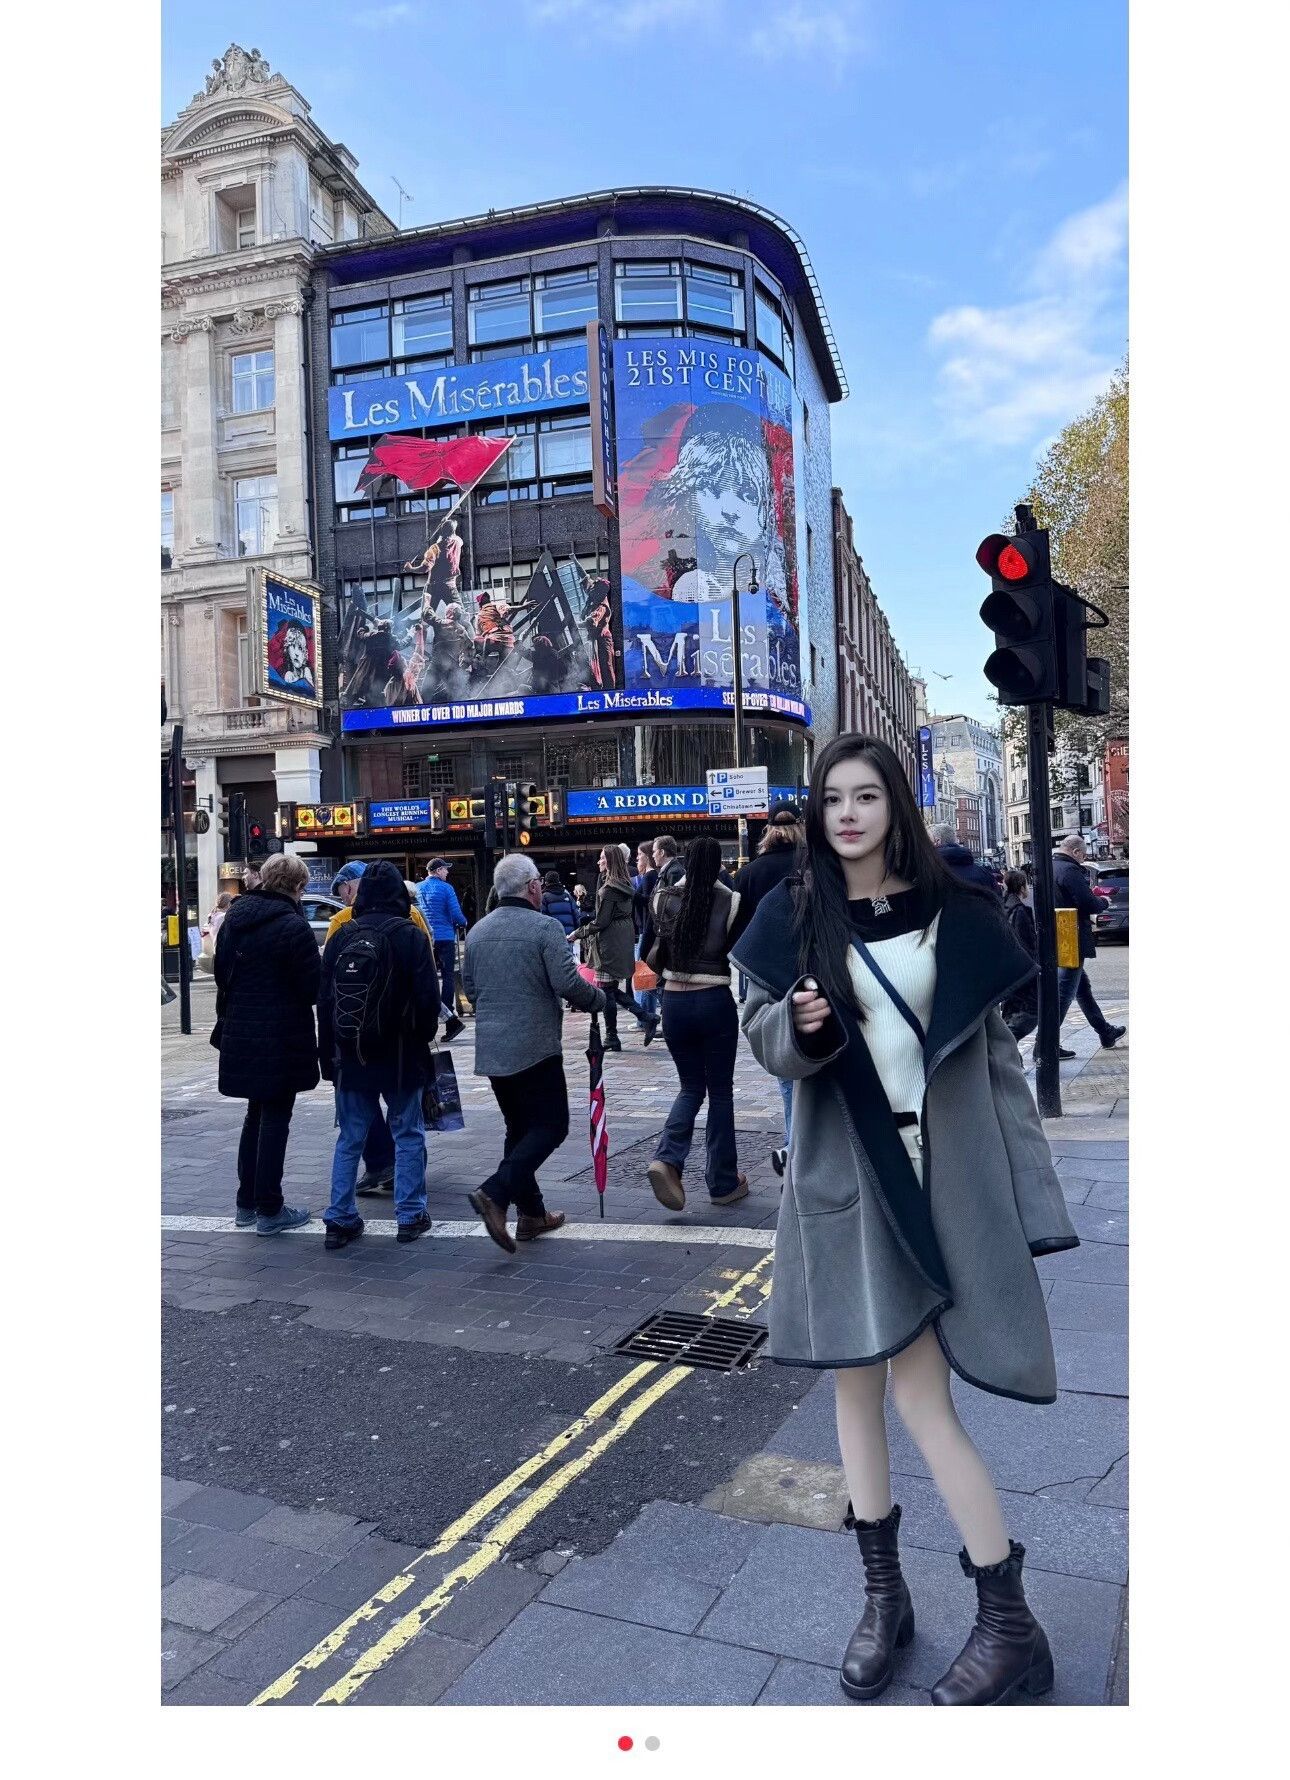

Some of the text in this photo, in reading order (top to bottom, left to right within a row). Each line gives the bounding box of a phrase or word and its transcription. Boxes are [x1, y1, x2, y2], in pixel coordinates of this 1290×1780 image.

[626, 350, 667, 367] LES
[678, 350, 718, 369] MIS
[727, 357, 765, 379] FOR
[627, 366, 694, 386] 21ST
[342, 358, 588, 430] Les Misérables
[268, 592, 312, 624] Misérables
[283, 592, 296, 606] Les
[709, 608, 756, 645] Ls
[577, 689, 673, 711] Les Misérables
[391, 710, 420, 724] WINNER
[421, 709, 431, 722] OF
[431, 707, 450, 721] OVER
[466, 703, 493, 718] MAJOR
[494, 701, 524, 716] AWARDS
[394, 804, 420, 812] WORLD'S
[615, 793, 686, 808] REBORN
[400, 809, 428, 817] RUNNING
